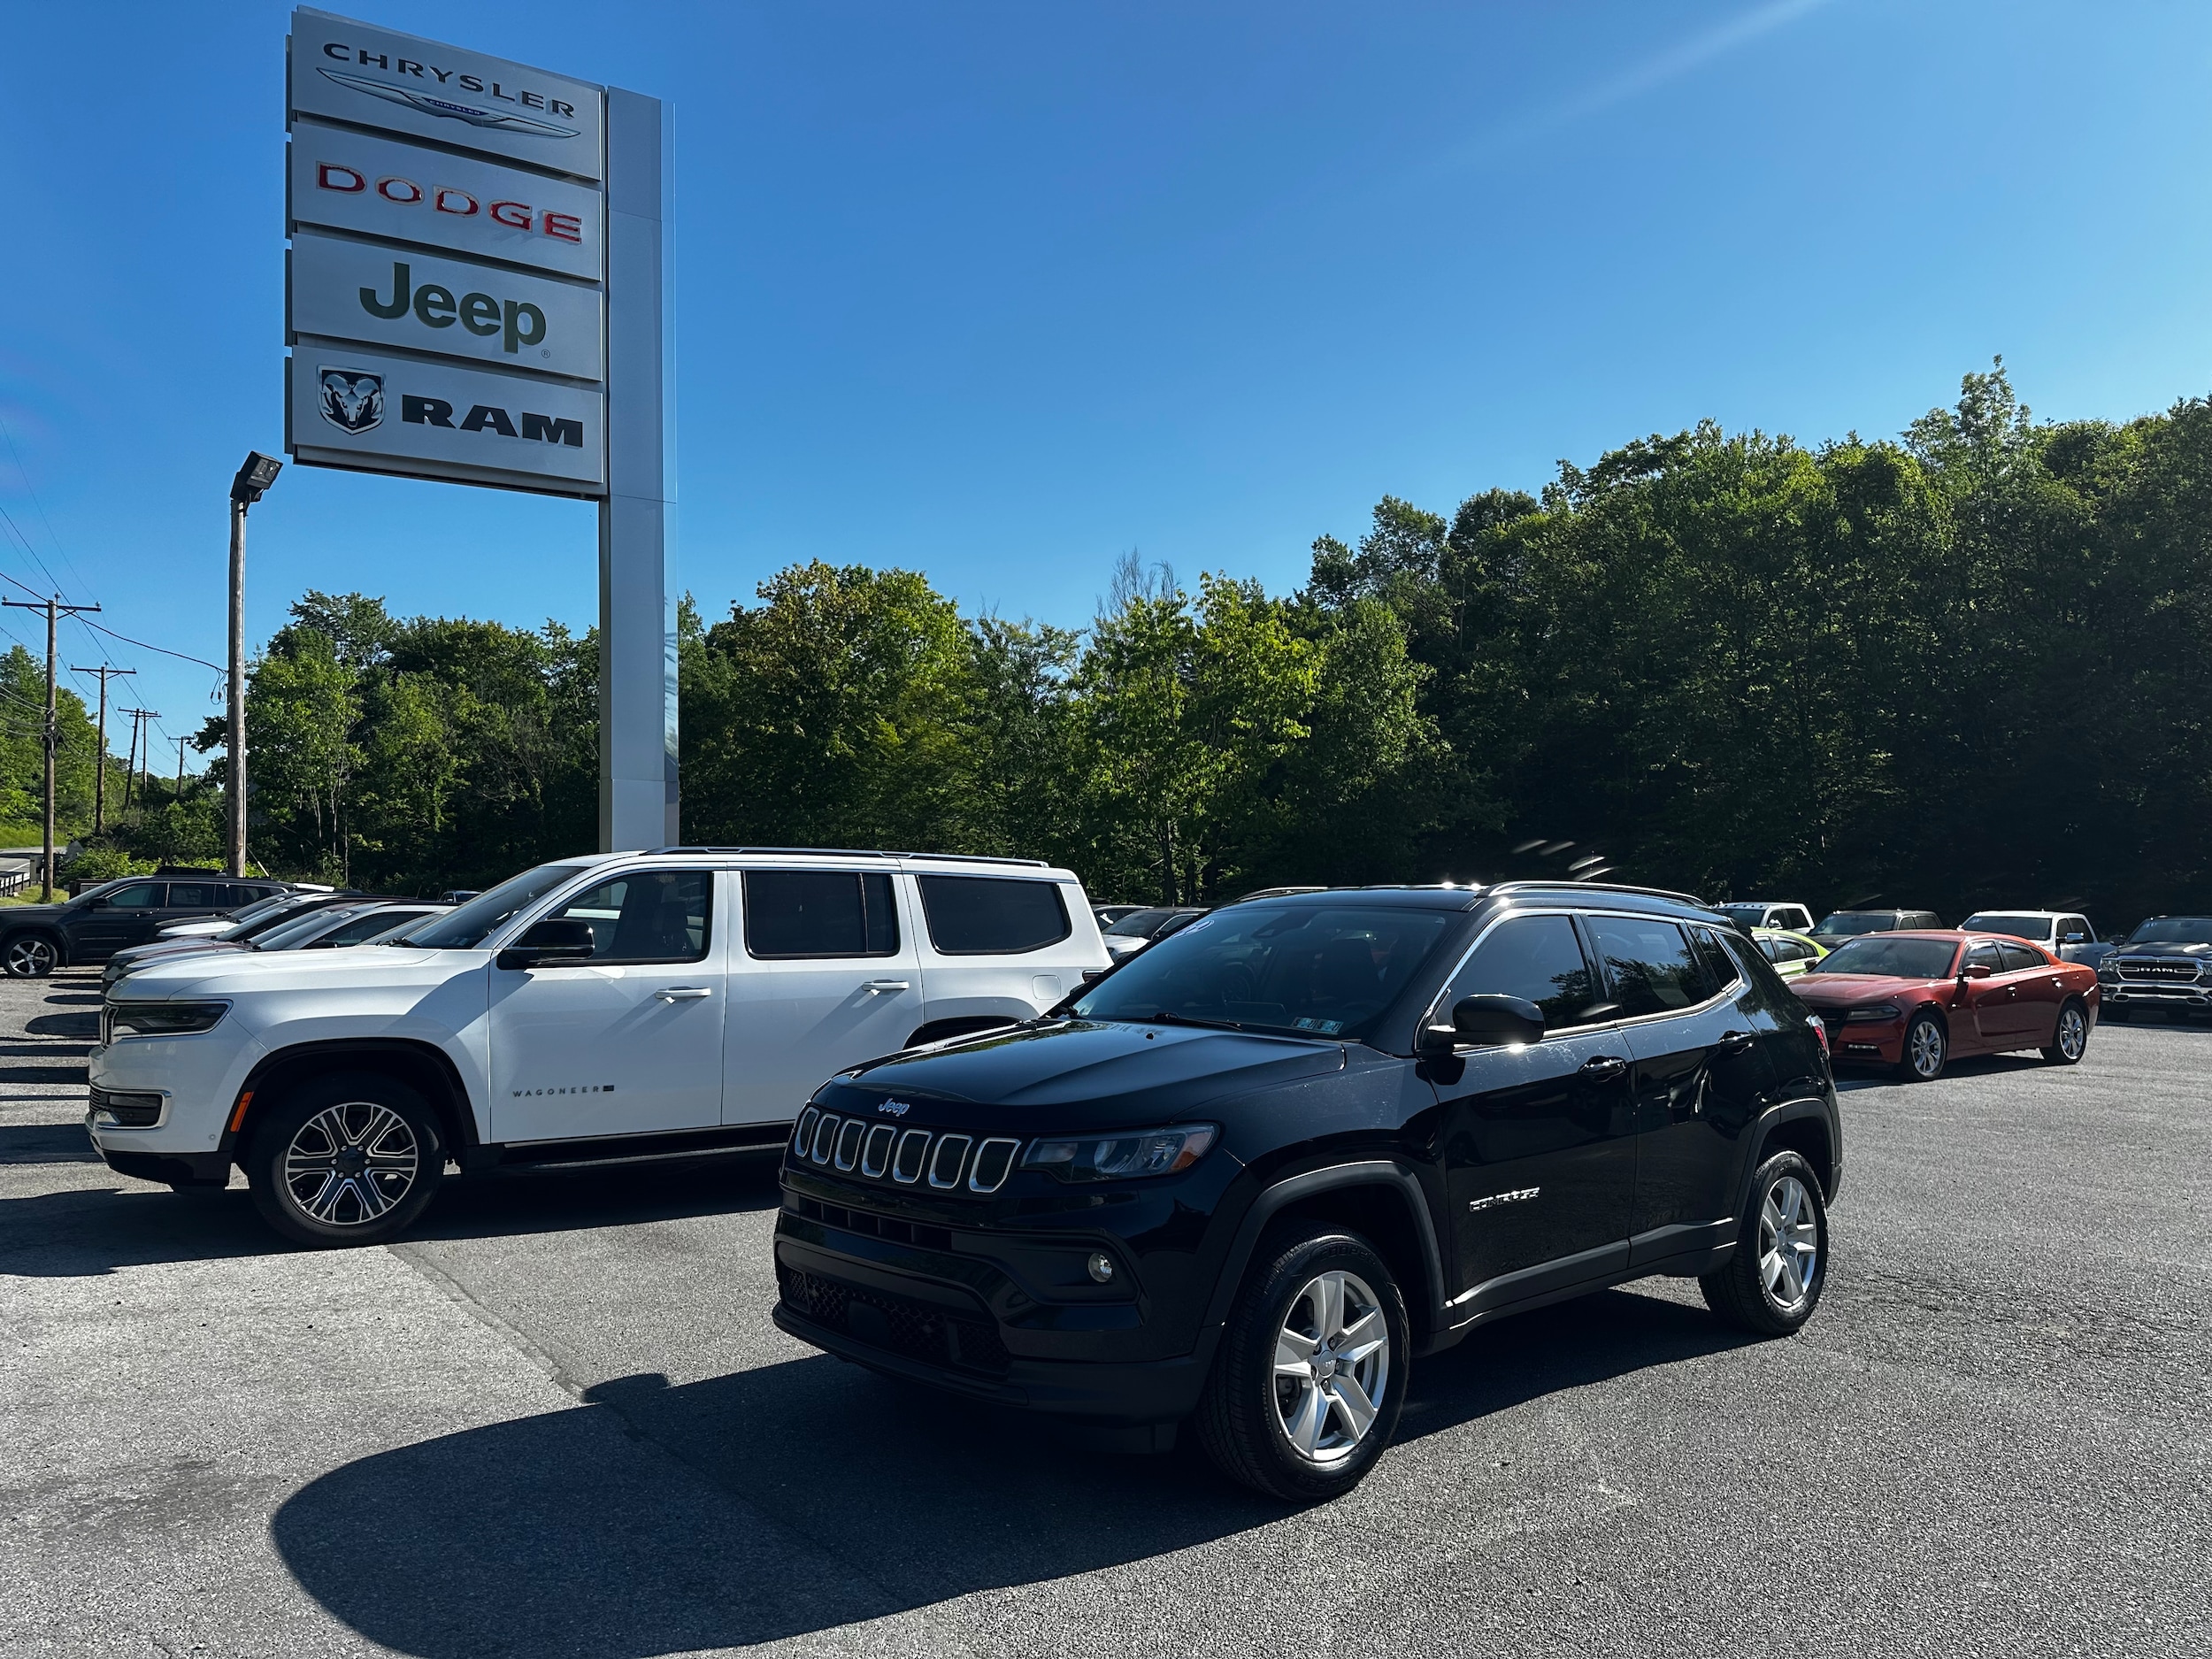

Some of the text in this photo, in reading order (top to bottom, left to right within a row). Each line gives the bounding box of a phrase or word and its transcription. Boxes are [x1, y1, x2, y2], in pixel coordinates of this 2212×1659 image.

[322, 42, 576, 119] CHRYSLER
[316, 161, 583, 244] DODGE
[359, 262, 547, 353] Jeep
[402, 394, 583, 448] RAM
[512, 1086, 599, 1097] WAGONEER
[878, 1097, 910, 1117] Jeep
